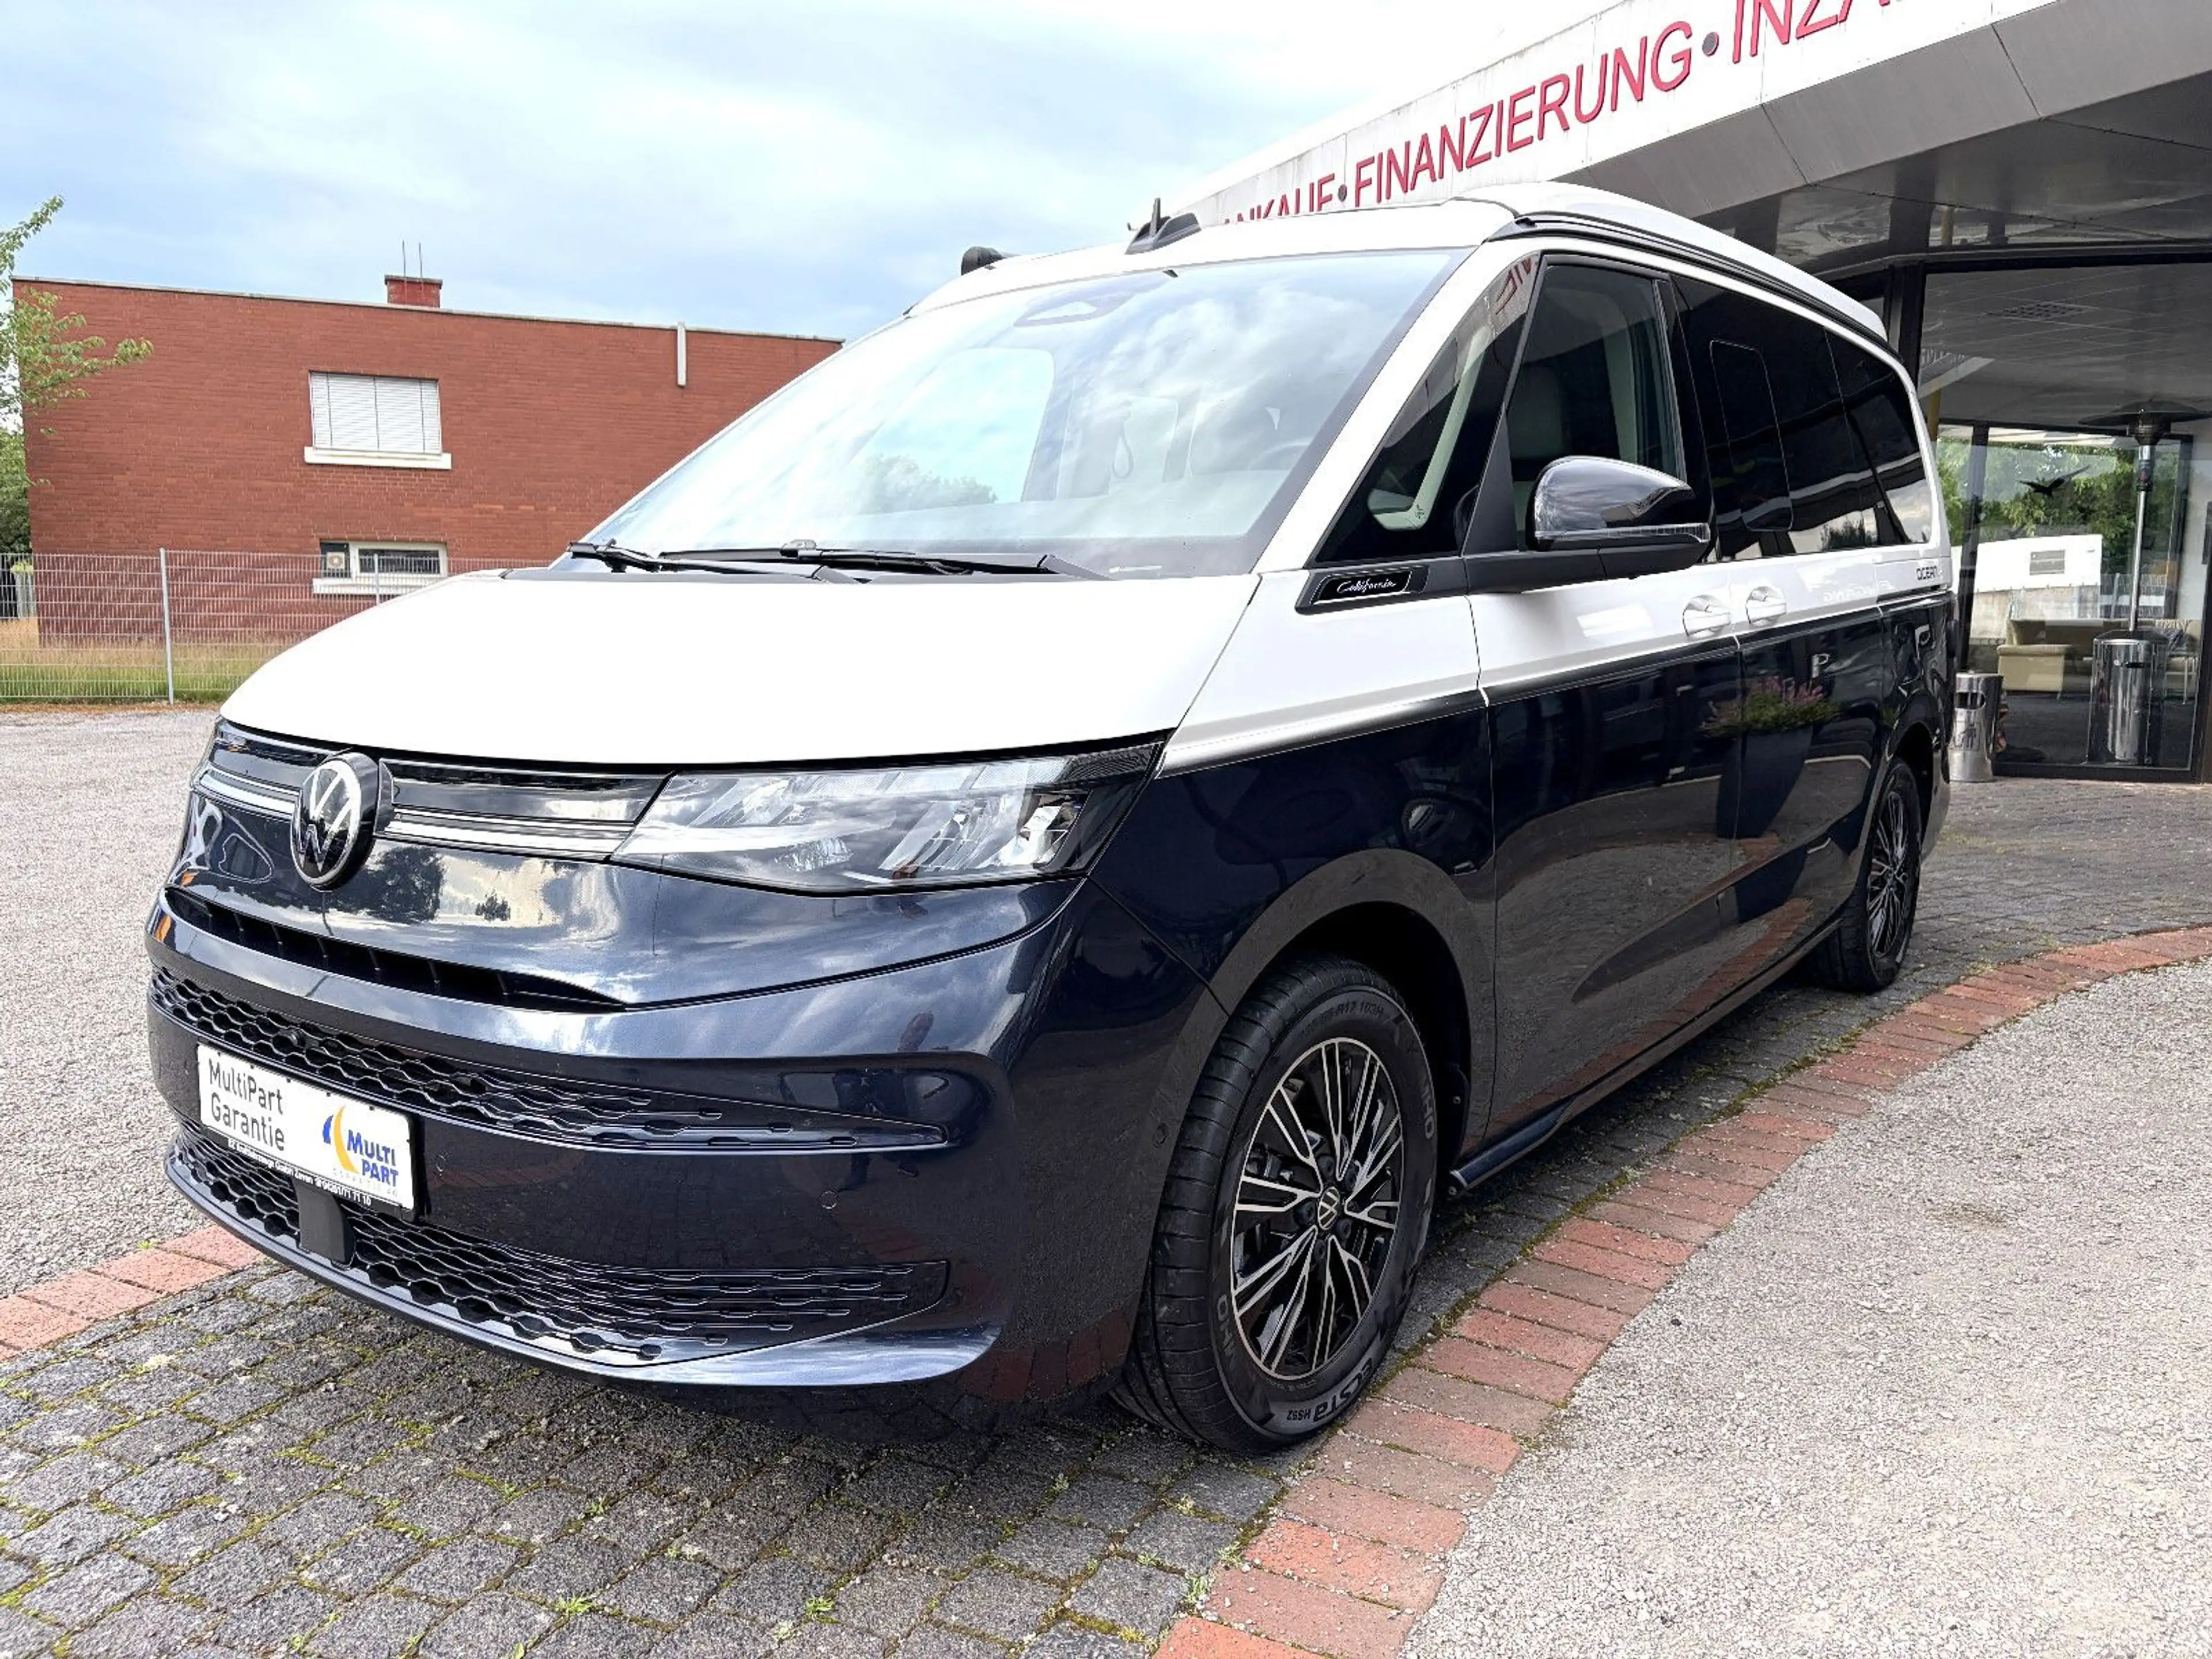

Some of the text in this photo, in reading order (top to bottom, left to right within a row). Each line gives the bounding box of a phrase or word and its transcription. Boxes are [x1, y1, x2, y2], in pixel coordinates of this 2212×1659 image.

[1224, 173, 1335, 224] KAUF
[1355, 21, 1692, 208] FINANZIERUNG
[1336, 578, 1396, 594] California
[209, 1058, 283, 1115] MultiPart
[211, 1093, 285, 1152] Garantie
[347, 1129, 396, 1167] MULTI
[362, 1158, 399, 1187] PART
